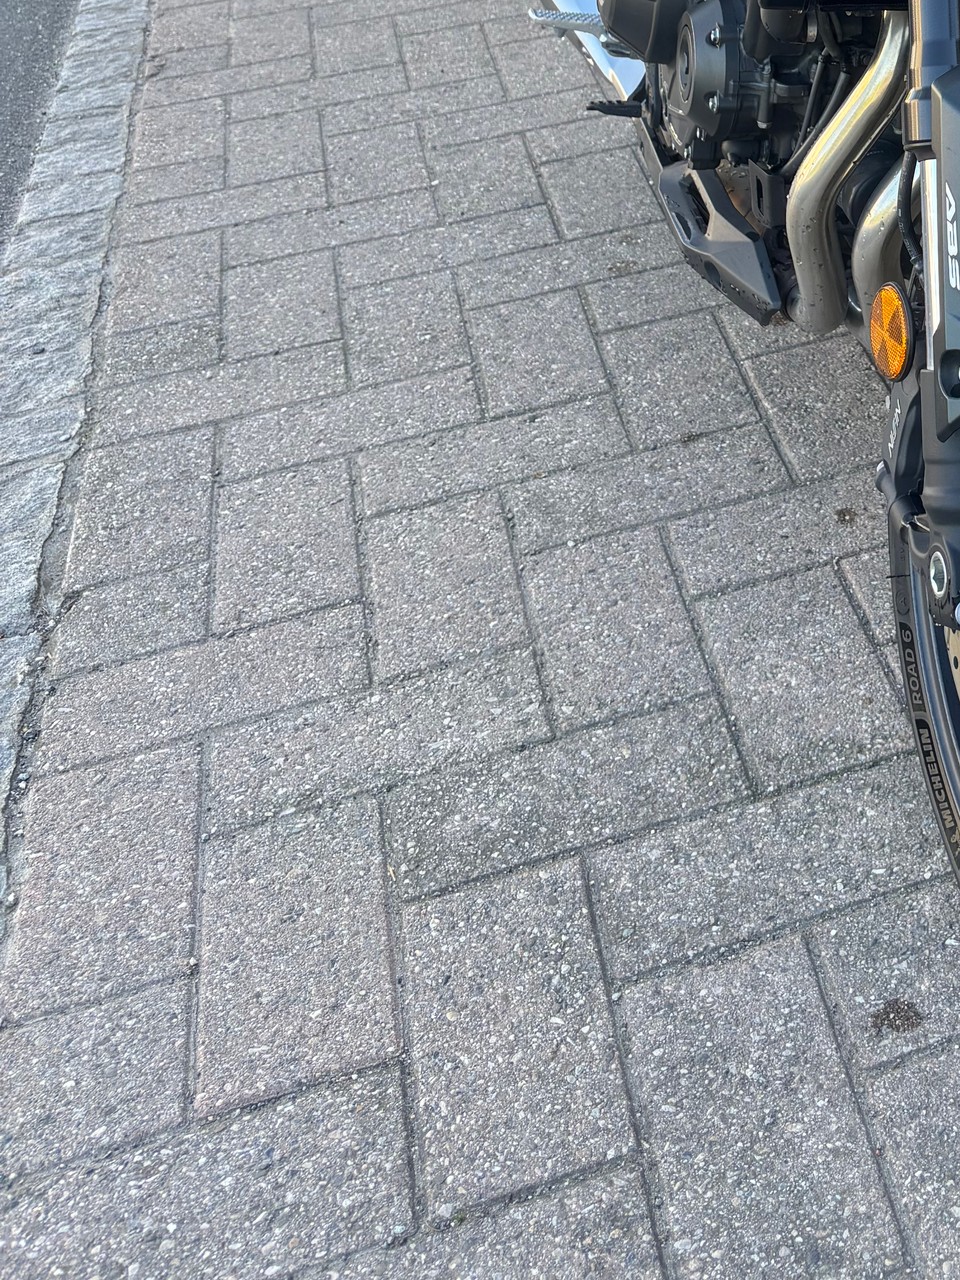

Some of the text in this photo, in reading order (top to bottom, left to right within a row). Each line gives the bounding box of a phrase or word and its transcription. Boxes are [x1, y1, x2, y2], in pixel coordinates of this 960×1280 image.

[945, 181, 960, 291] ABS
[902, 628, 955, 829] MICHELIN ROAD 6
